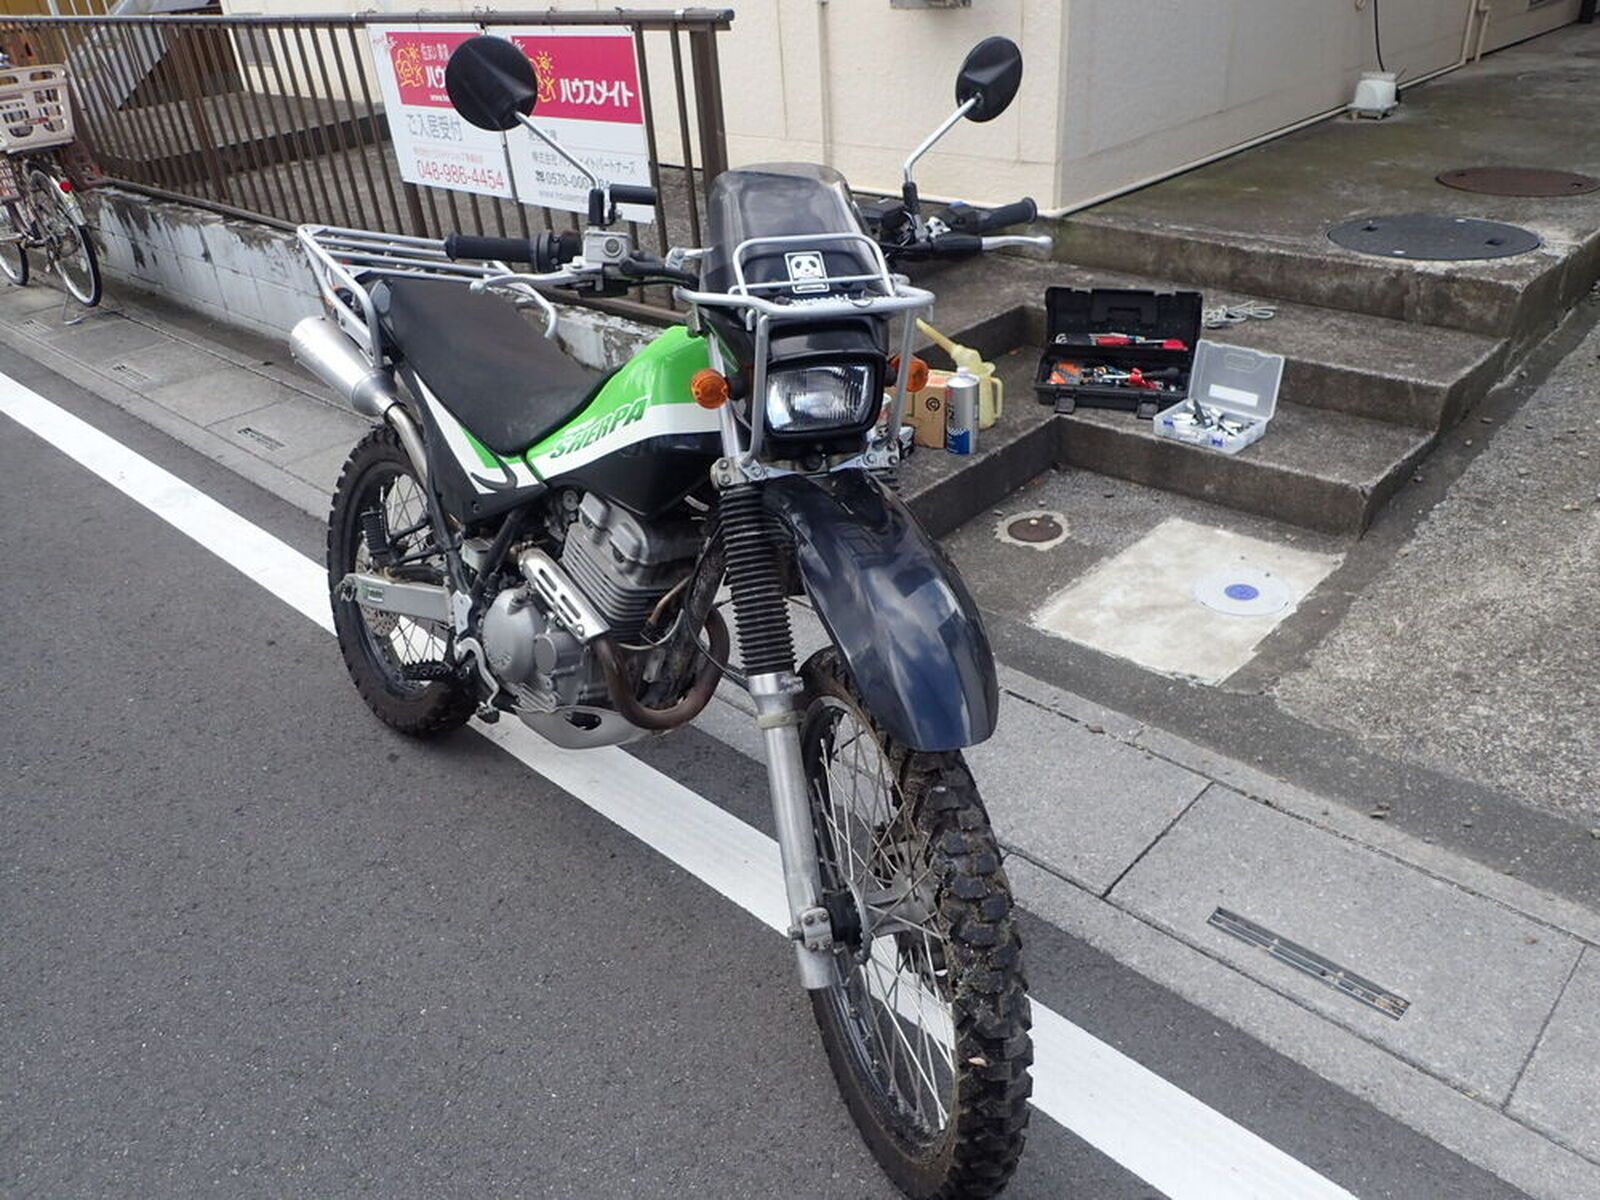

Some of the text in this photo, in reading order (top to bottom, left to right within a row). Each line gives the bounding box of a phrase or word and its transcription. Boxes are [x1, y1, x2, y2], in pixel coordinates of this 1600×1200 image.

[560, 77, 635, 107] ハウスメイト
[417, 159, 504, 189] 048-986-4454
[550, 397, 648, 458] SHERPA
